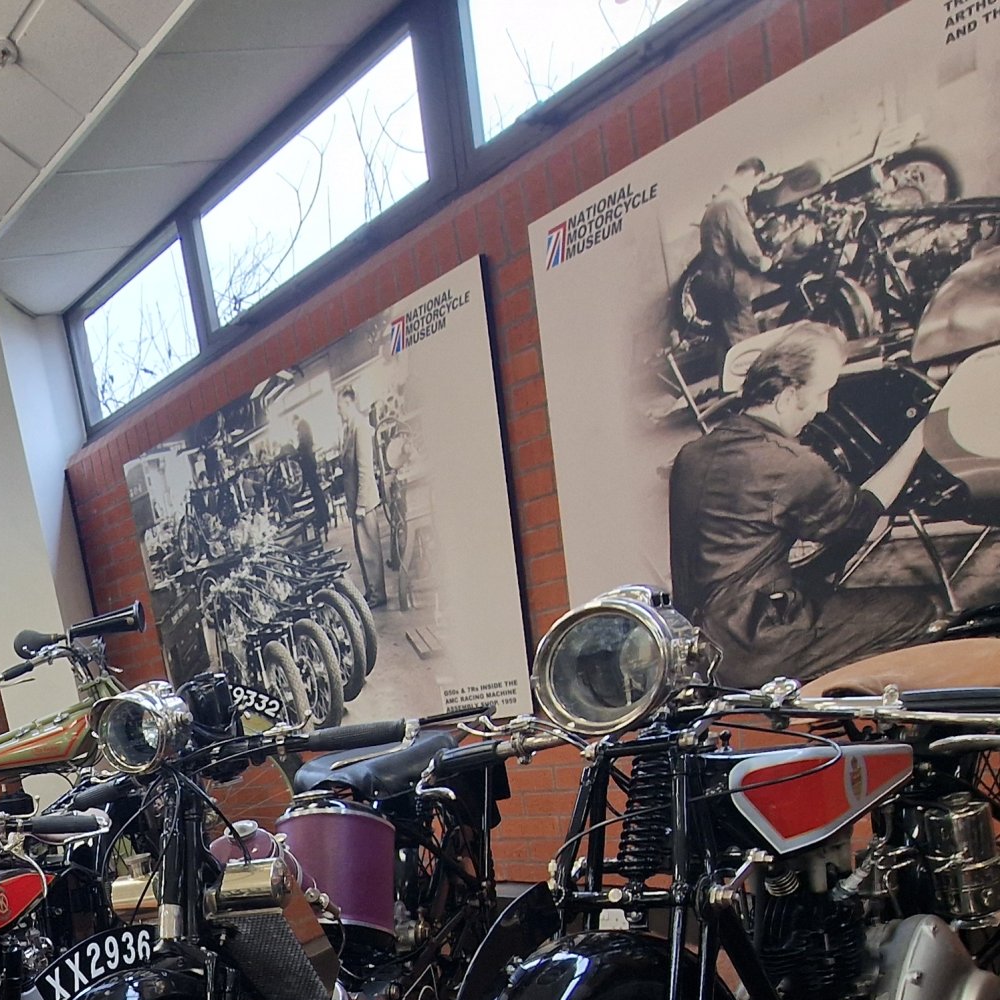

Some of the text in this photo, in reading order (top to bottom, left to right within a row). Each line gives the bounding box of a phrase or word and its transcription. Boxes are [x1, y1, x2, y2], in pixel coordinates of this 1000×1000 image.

[946, 20, 977, 45] AND
[567, 183, 658, 246] MOTORCYCLE
[568, 183, 634, 231] NATIONAL
[566, 219, 623, 260] MUSEUM
[406, 289, 453, 323] NATIONAL
[406, 290, 470, 335] MOTORCYCLE
[406, 317, 446, 348] MUSEUM
[445, 689, 517, 705] AMC RACING MACHINE
[480, 682, 503, 691] INSIDE
